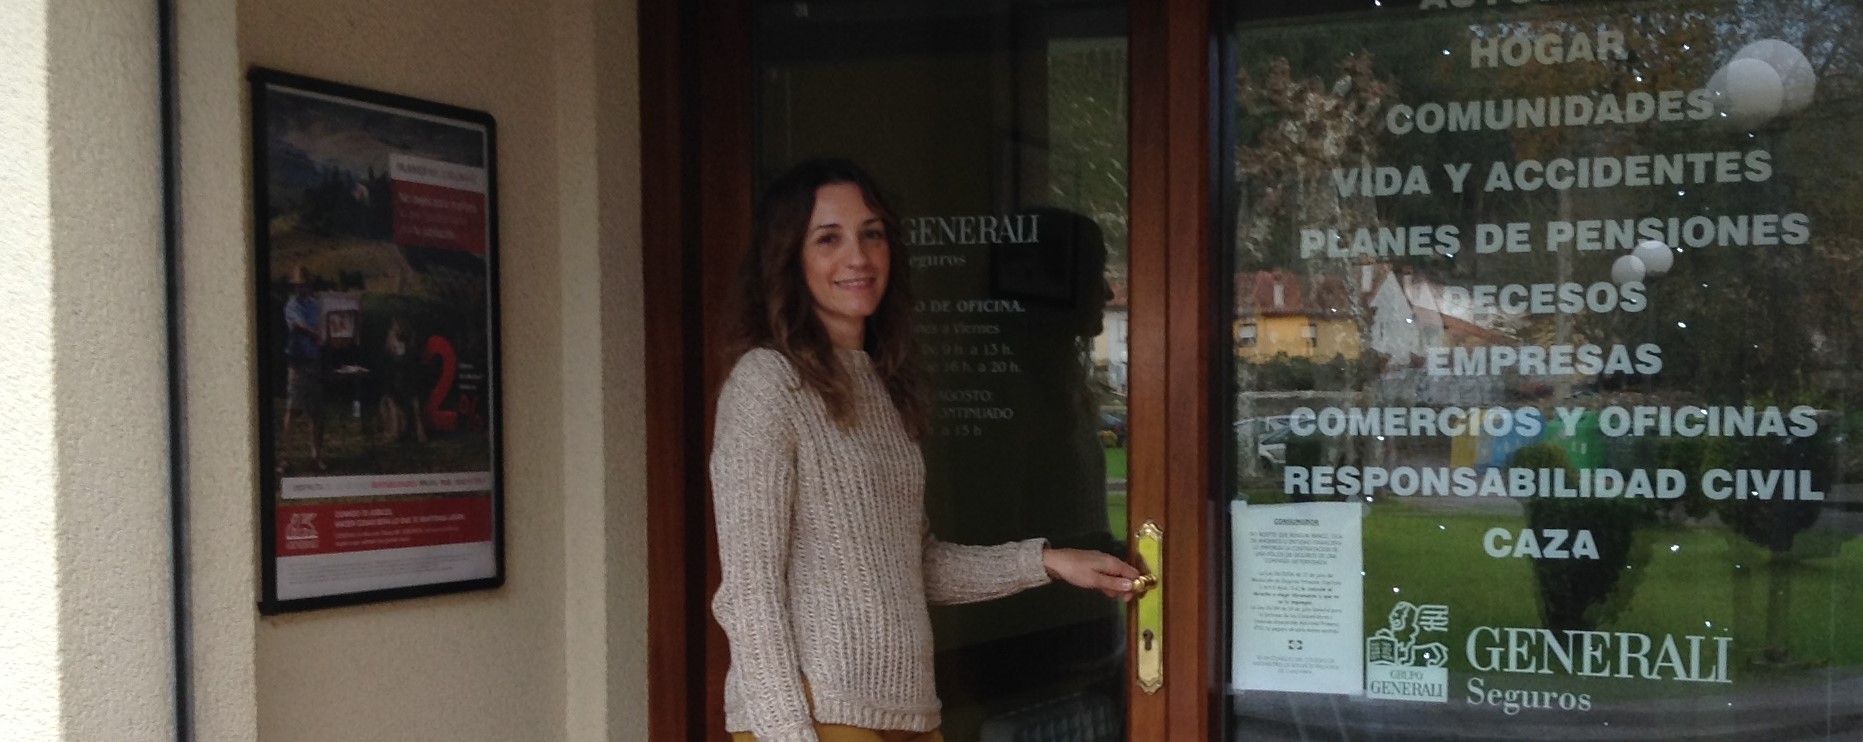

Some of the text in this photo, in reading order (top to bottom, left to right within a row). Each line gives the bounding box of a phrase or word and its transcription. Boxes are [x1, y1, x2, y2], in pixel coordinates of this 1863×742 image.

[1470, 30, 1628, 68] HOGAR
[1386, 88, 1714, 136] COMUNIDADES
[1334, 149, 1773, 198] VIDA Y ACCIDENTES
[900, 214, 1040, 246] GENERALI
[1299, 212, 1811, 260] PLANES DE PENSIONES
[909, 254, 967, 271] eguros
[930, 300, 952, 313] DE
[1443, 281, 1648, 316] DECESOS
[991, 361, 1007, 373] 20
[1427, 343, 1663, 377] EMPRESAS
[1290, 405, 1819, 438] COMERCIOS Y OFICINAS
[1284, 465, 1826, 502] RESPONSABILIDAD CIVIL
[1483, 528, 1601, 560] CAZA
[1466, 626, 1734, 684] GENERALI
[1370, 680, 1444, 698] GENERALI
[1390, 669, 1423, 680] GRUPO
[1466, 677, 1592, 716] Seguros
